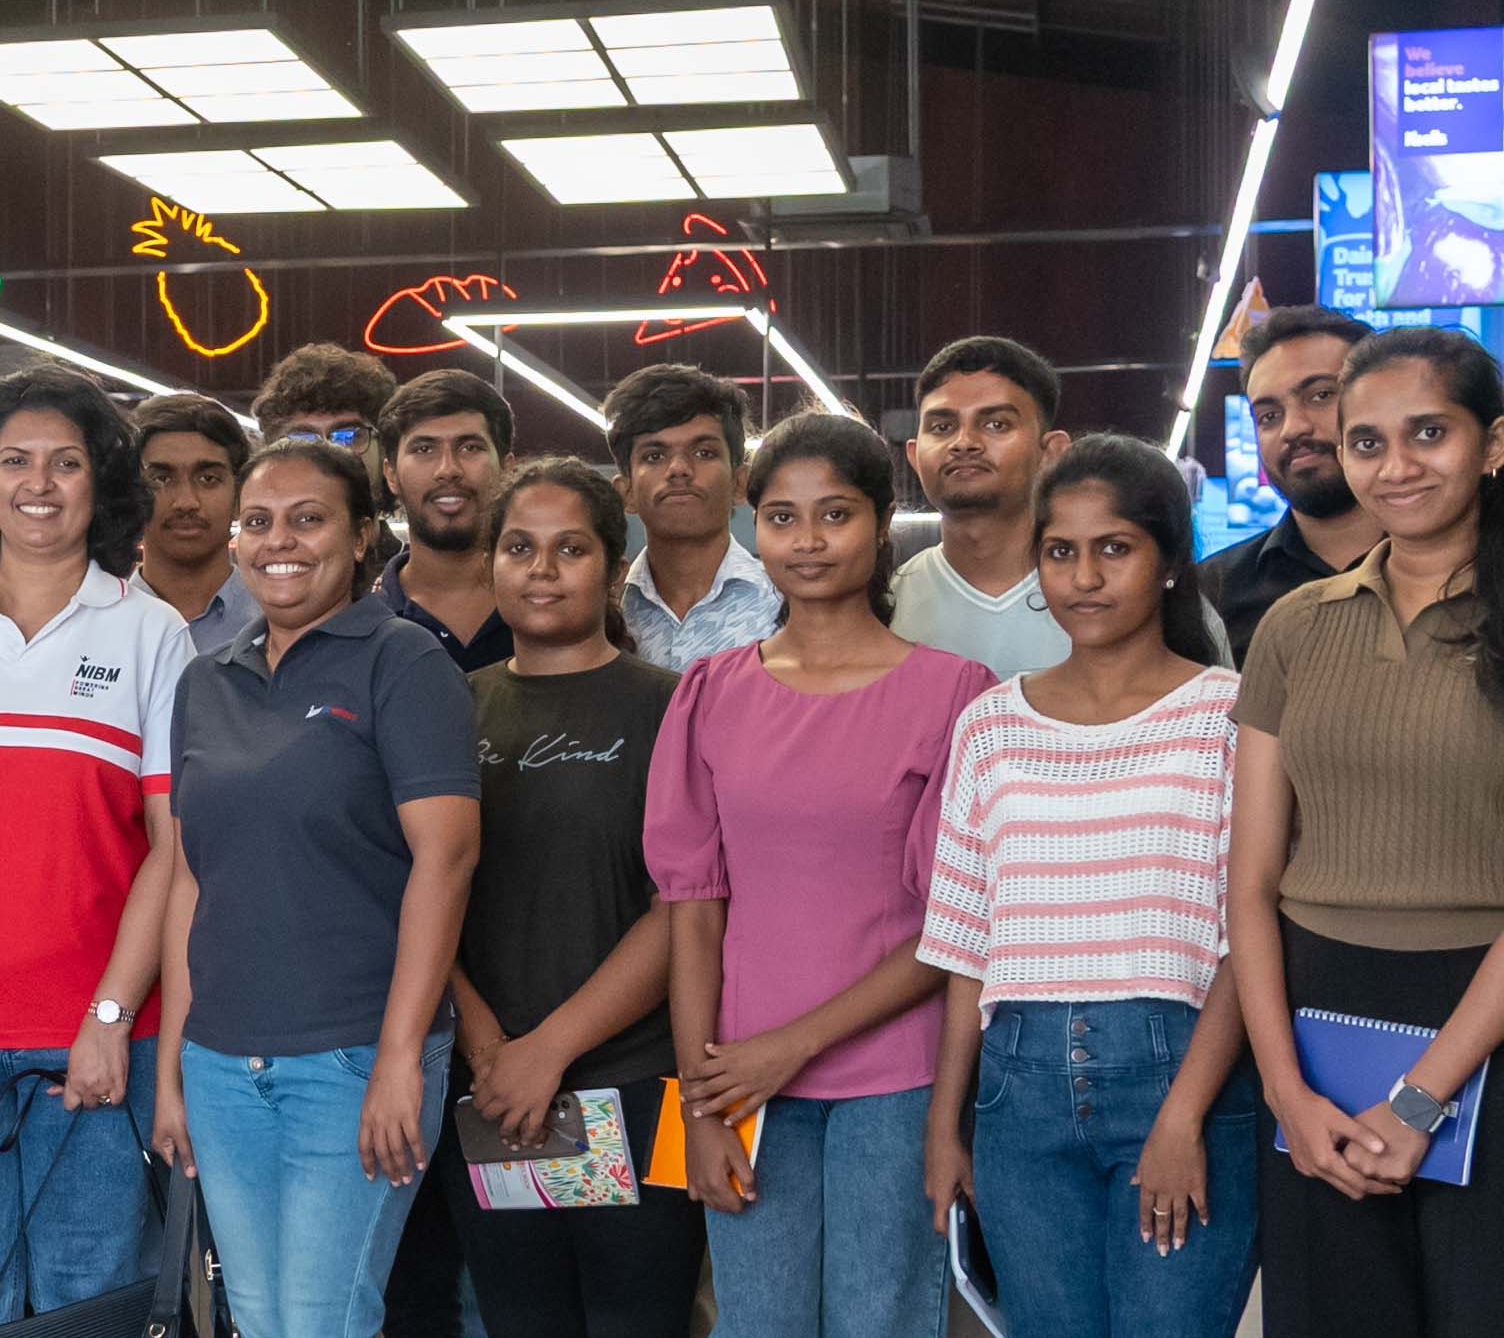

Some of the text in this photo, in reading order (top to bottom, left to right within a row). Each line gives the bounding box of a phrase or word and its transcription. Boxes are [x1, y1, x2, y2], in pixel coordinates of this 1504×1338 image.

[1404, 47, 1432, 61] We
[1404, 62, 1465, 78] believe
[1403, 78, 1445, 95] local
[75, 663, 121, 682] NIBM
[518, 733, 625, 771] Kind
